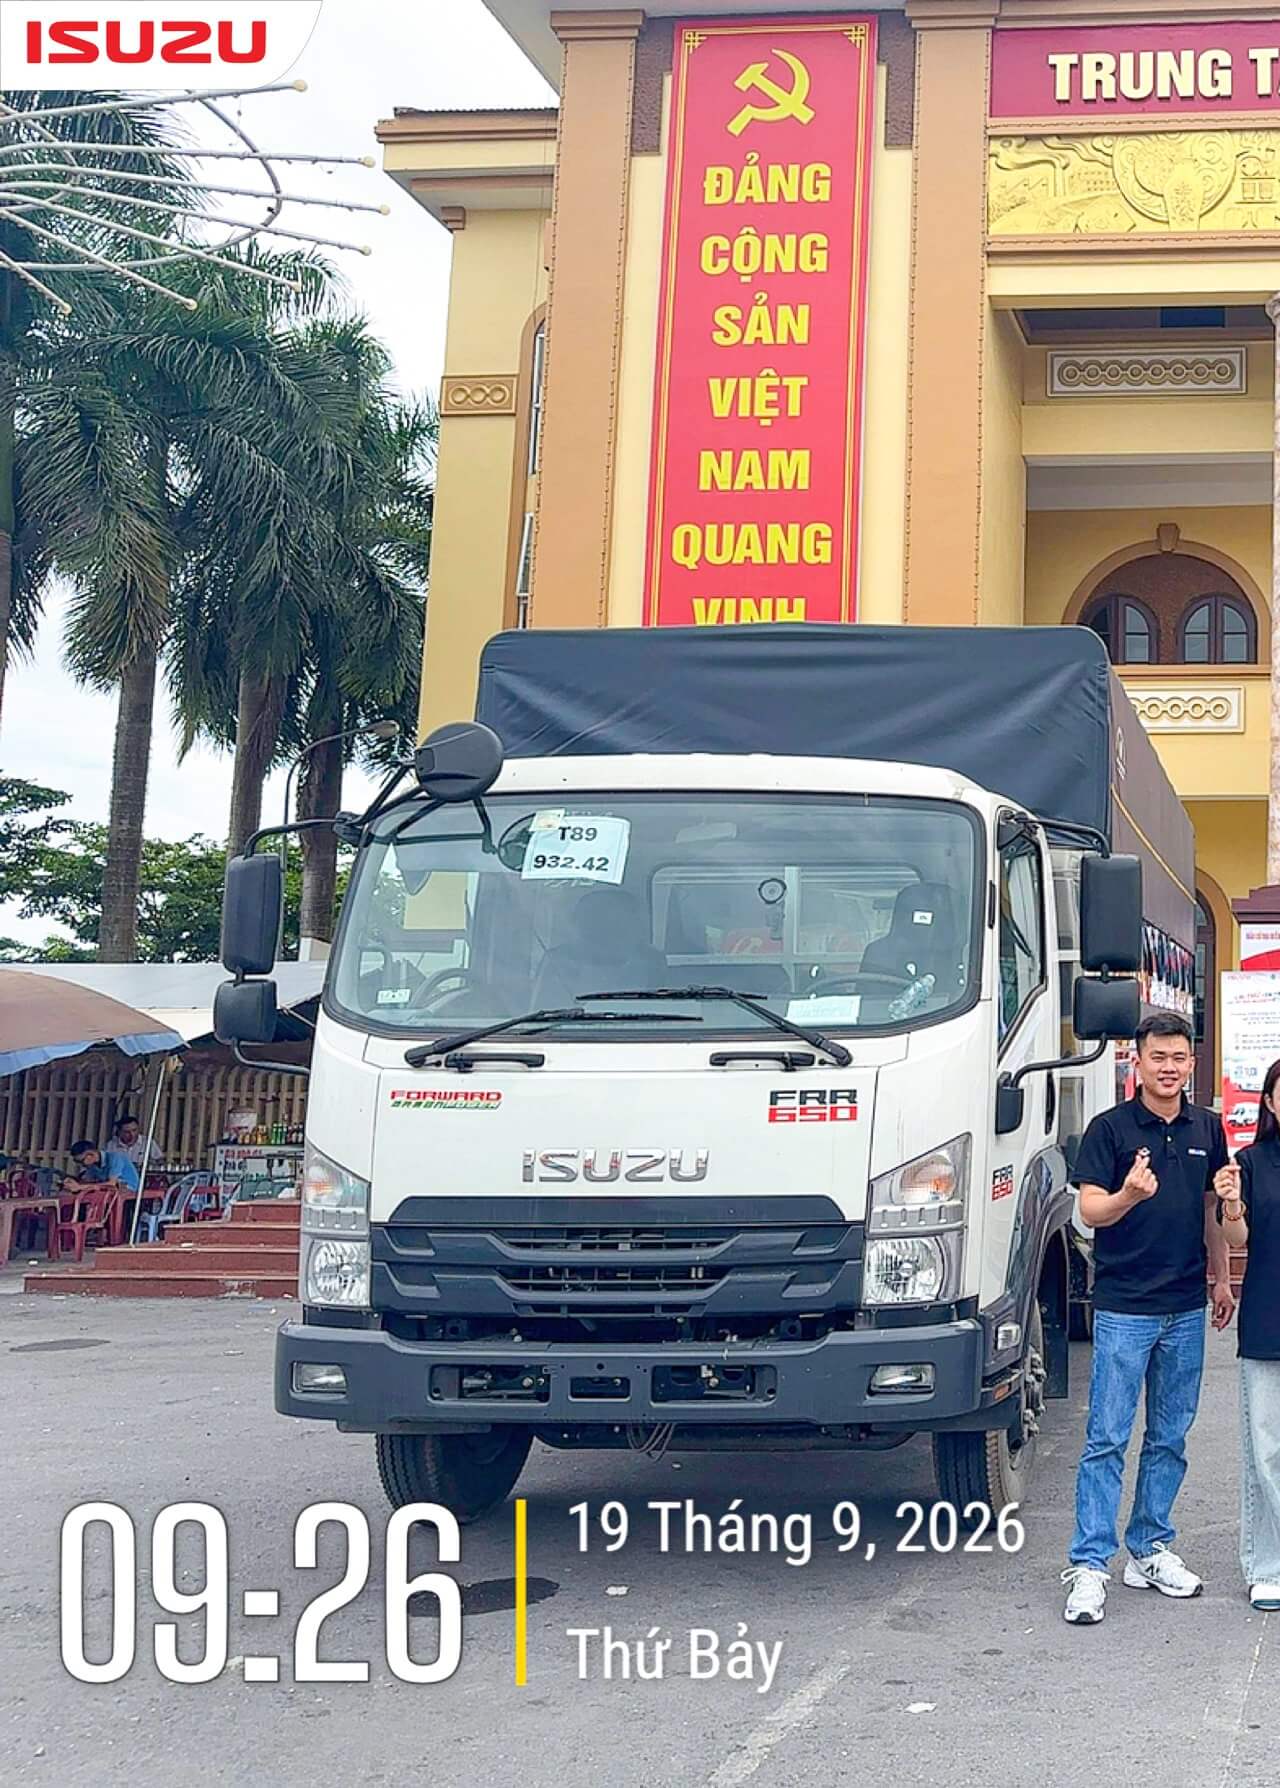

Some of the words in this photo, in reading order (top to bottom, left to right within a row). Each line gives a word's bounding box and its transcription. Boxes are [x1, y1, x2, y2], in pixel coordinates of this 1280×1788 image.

[1048, 48, 1233, 101] TRUNG
[703, 151, 832, 207] ĐẢNG
[701, 225, 829, 282] CỘNG
[711, 291, 810, 346] SẢN
[709, 368, 808, 427] VIỆT
[699, 450, 811, 492] NAM
[671, 522, 833, 569] QUANG
[692, 597, 807, 627] VINH
[558, 826, 598, 841] T89
[533, 854, 610, 872] 932.42
[390, 1090, 503, 1101] FORWARD
[769, 1089, 858, 1106] FRR
[768, 1106, 858, 1123] 650
[522, 1147, 710, 1183] ISUZU
[992, 1164, 1014, 1185] FRR
[991, 1179, 1014, 1201] 650
